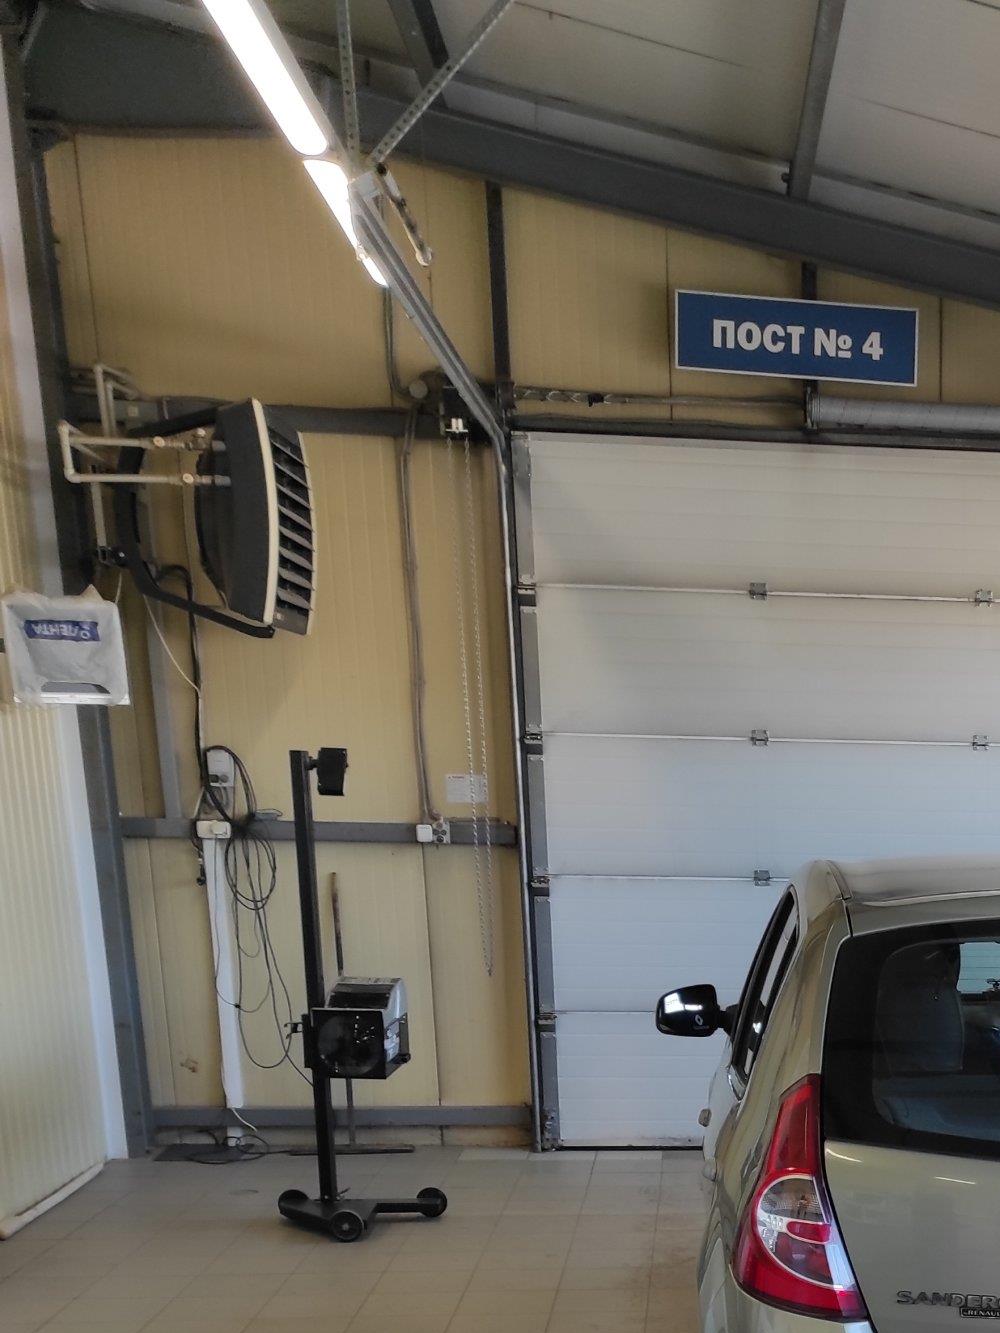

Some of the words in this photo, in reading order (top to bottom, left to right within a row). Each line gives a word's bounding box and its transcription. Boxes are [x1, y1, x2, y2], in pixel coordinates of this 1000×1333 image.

[713, 318, 805, 355] ПОСТ
[813, 327, 852, 359] №
[862, 331, 884, 361] 4
